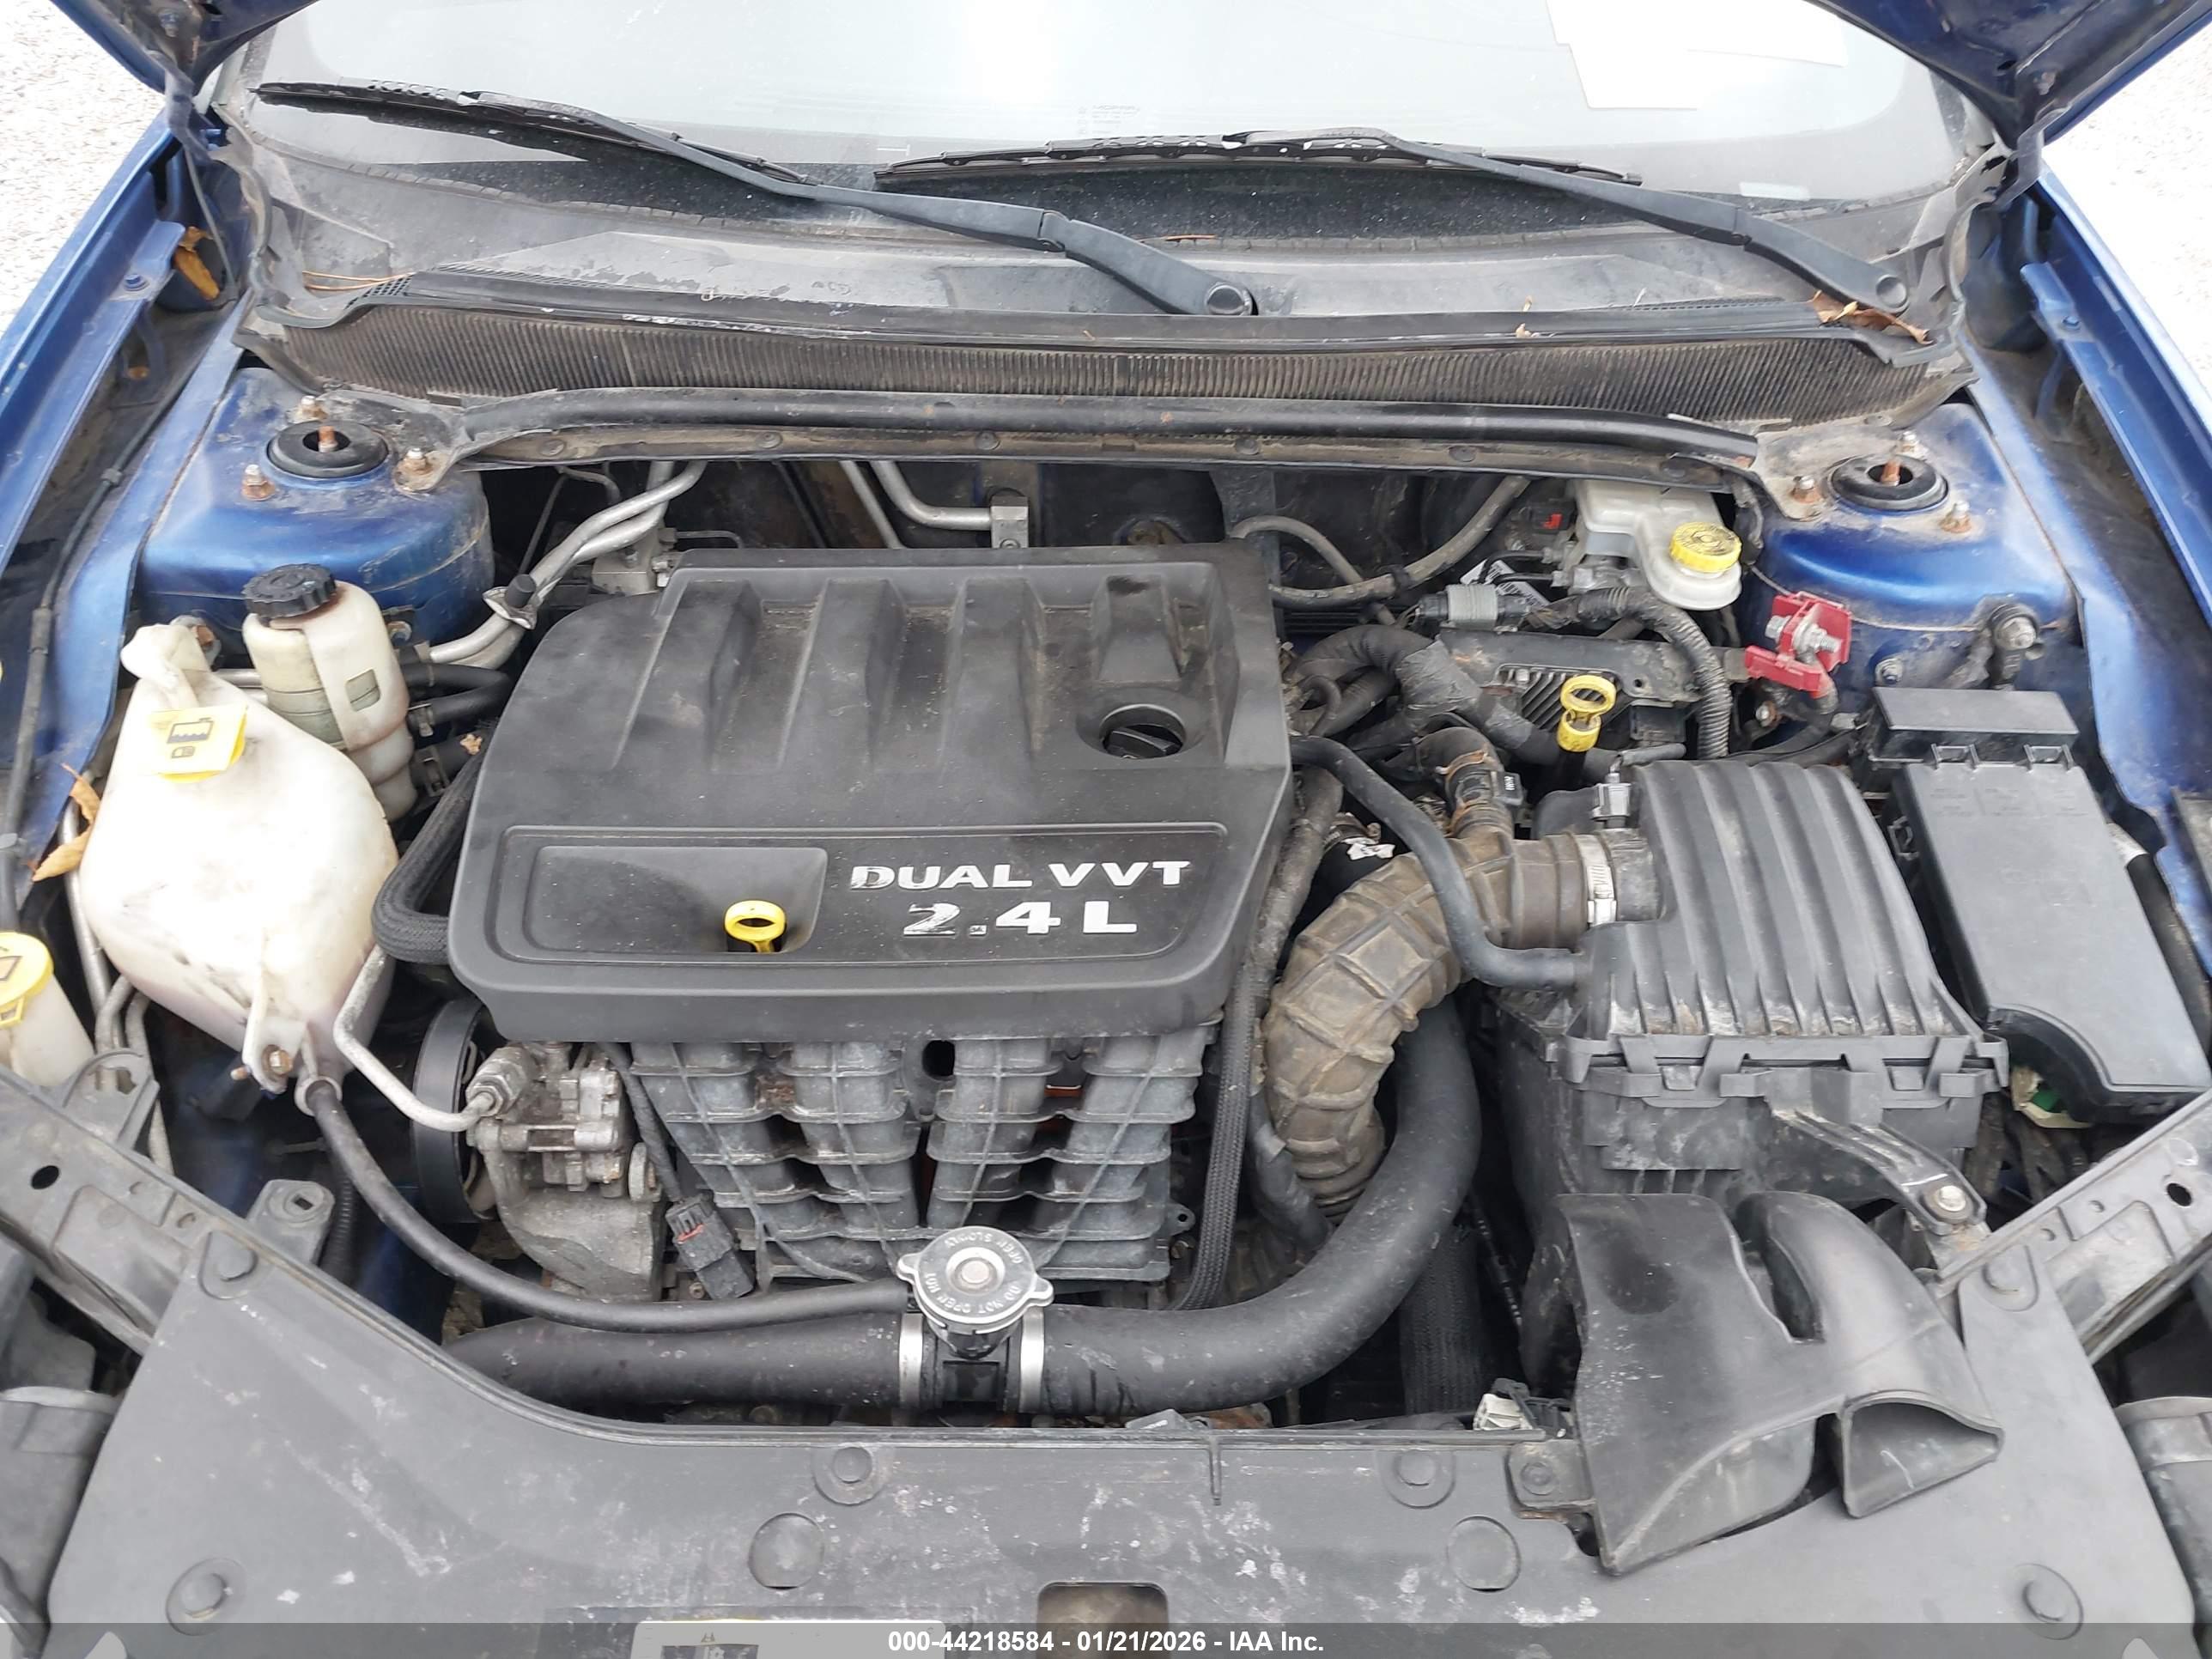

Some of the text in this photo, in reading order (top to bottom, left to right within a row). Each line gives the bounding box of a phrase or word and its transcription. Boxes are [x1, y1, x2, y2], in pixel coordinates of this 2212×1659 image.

[851, 860, 1192, 890] DUAL VVT
[945, 1231, 1024, 1264] OPEN SLOWLY
[925, 1273, 1022, 1314] DO NOT OPEN HOT
